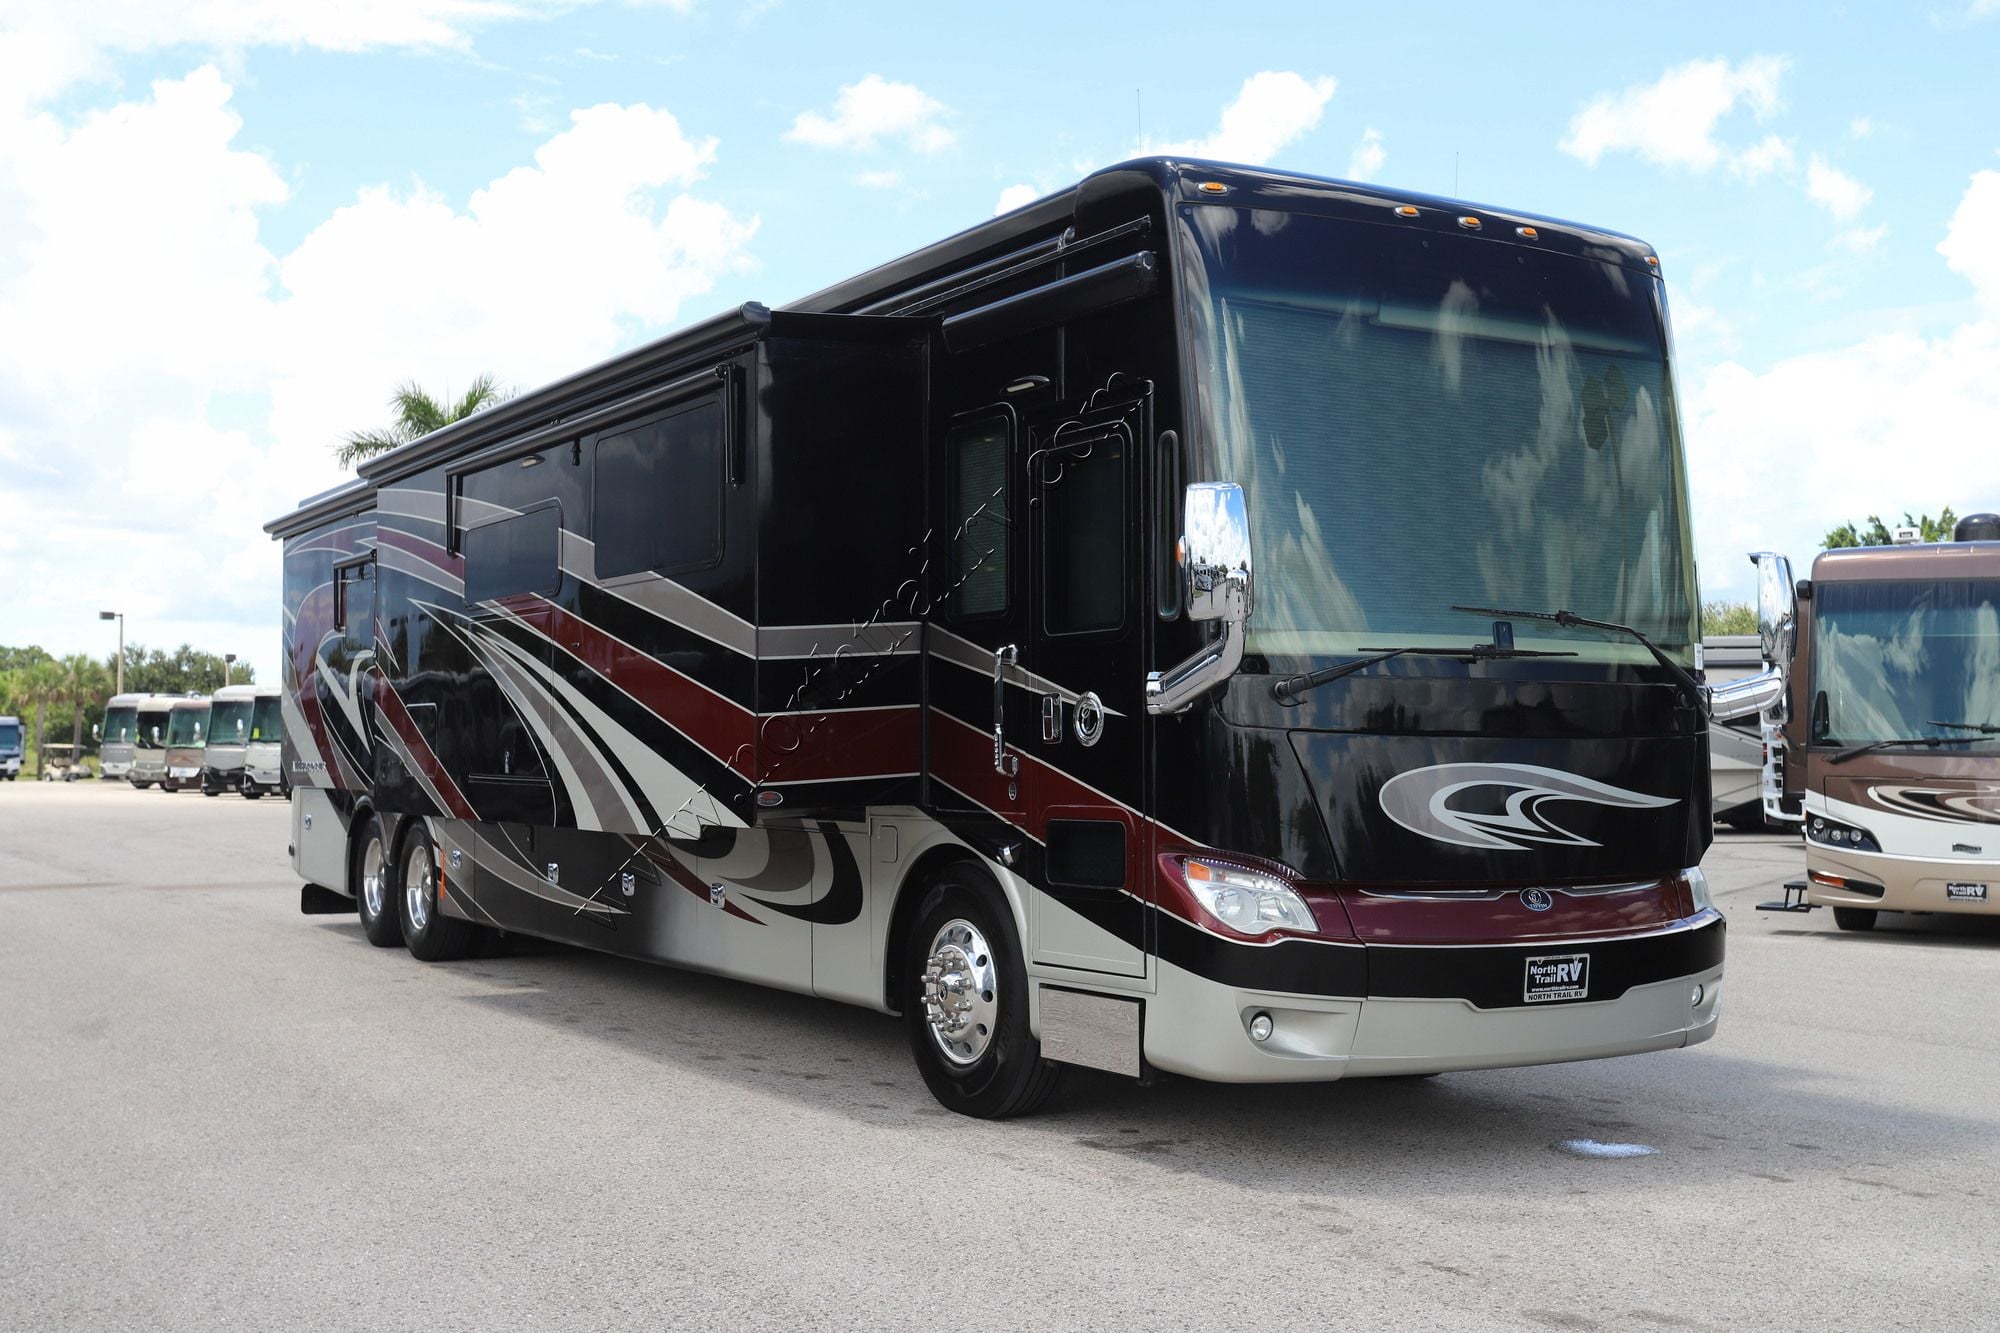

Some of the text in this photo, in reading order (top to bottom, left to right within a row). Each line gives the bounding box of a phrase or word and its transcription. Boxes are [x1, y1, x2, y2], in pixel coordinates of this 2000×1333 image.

[1967, 886, 1984, 896] RV
[1530, 965, 1557, 975] North
[1557, 962, 1583, 983] RV
[1535, 974, 1556, 984] Trail
[1528, 993, 1552, 1001] NORTH
[1554, 991, 1573, 999] TRAIL
